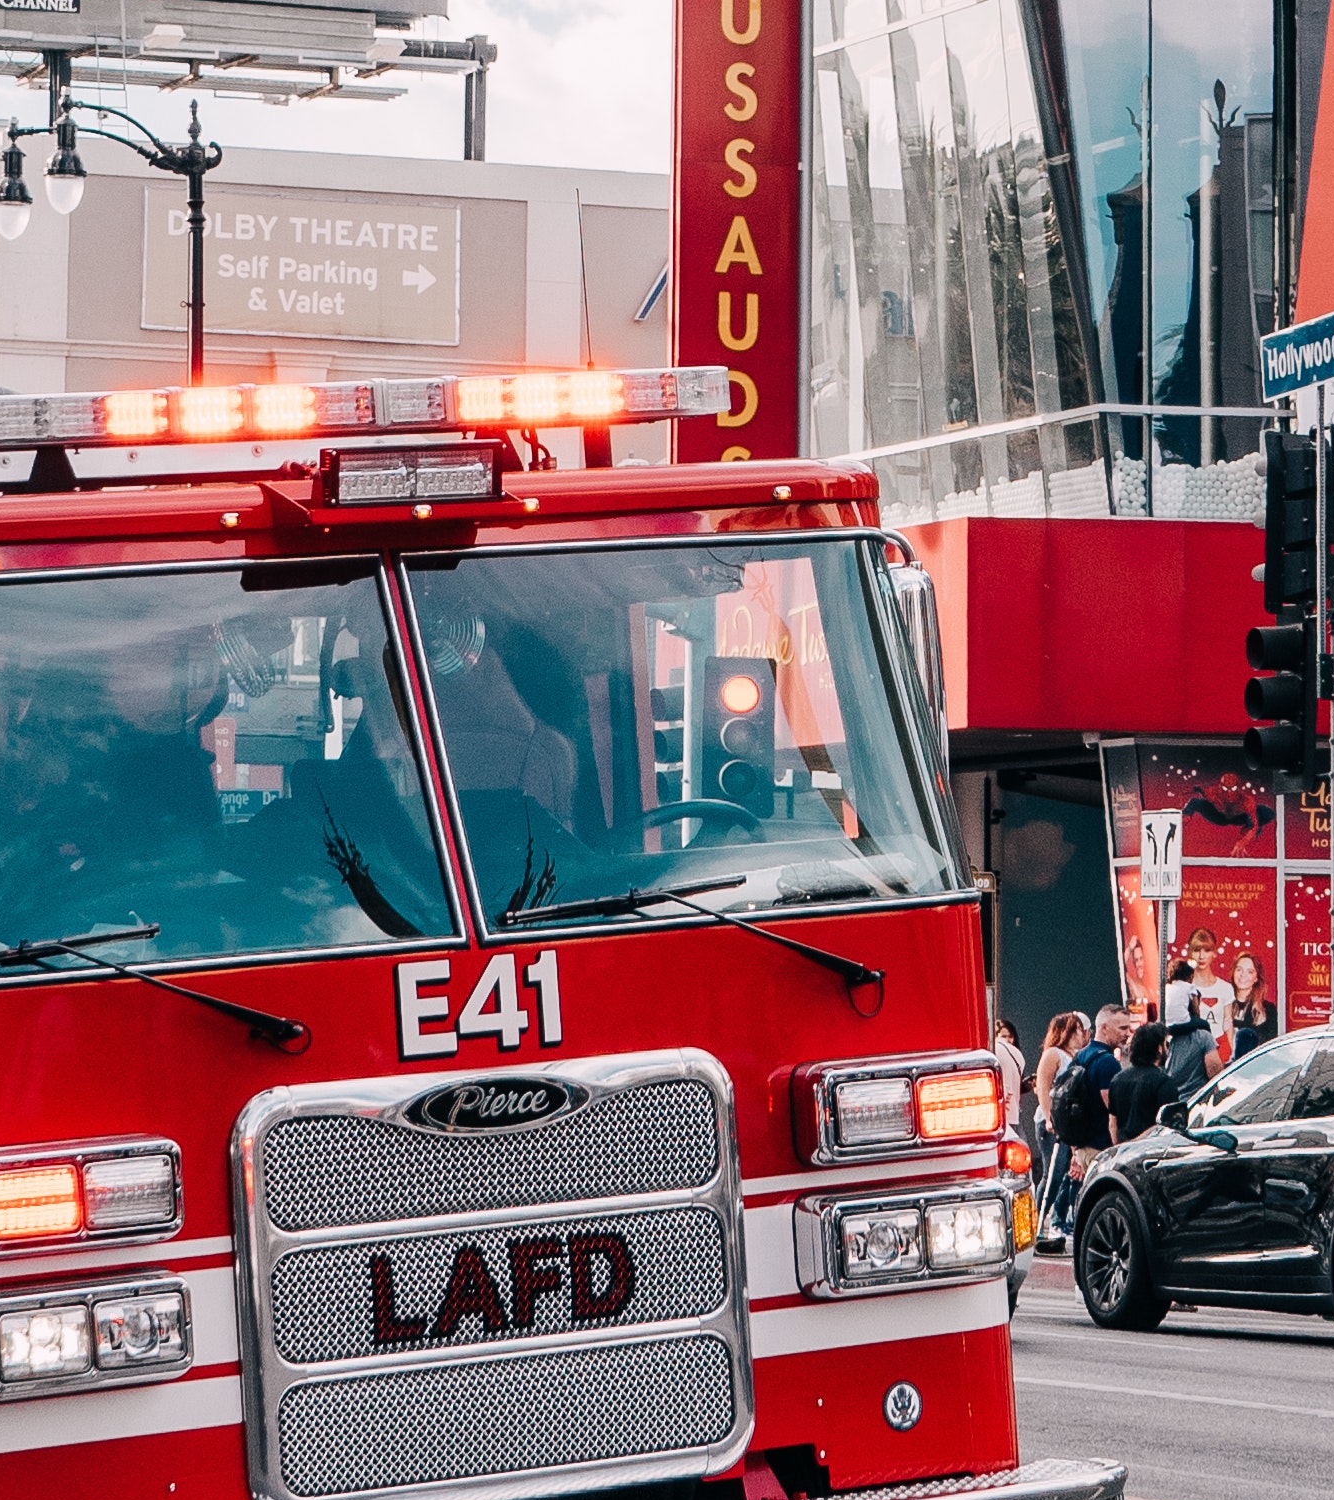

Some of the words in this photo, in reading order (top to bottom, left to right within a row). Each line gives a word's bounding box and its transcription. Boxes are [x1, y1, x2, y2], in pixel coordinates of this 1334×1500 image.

[289, 217, 439, 252] THEATRE
[217, 253, 269, 280] Self
[278, 257, 378, 292] Parking
[248, 287, 268, 311] &
[278, 288, 346, 316] Valet
[394, 949, 563, 1060] E41
[447, 1084, 550, 1132] Pierce
[368, 1228, 635, 1345] LAFD
